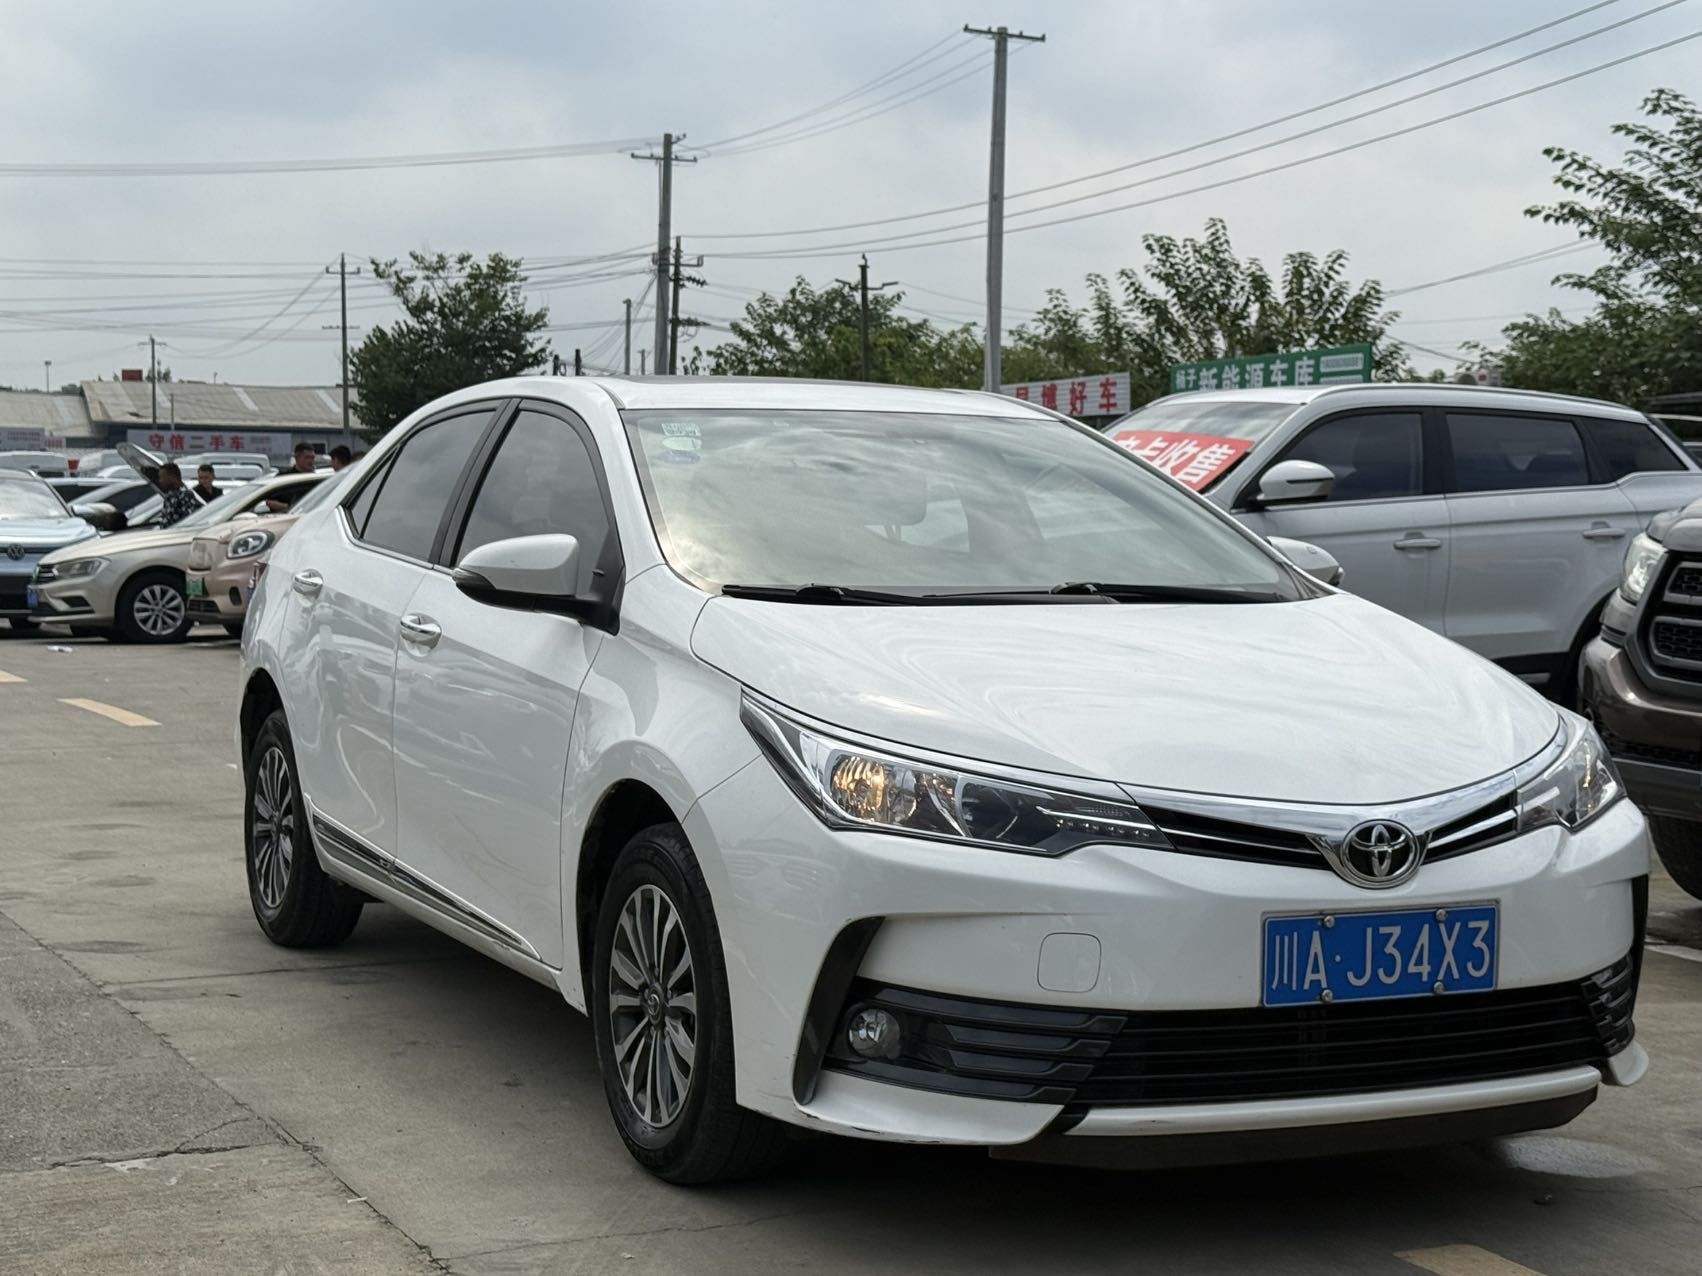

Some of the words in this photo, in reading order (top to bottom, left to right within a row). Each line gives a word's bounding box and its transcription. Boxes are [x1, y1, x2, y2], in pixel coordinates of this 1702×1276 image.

[148, 433, 245, 450] 守信二手车
[1271, 920, 1490, 990] 川A·J34X3
